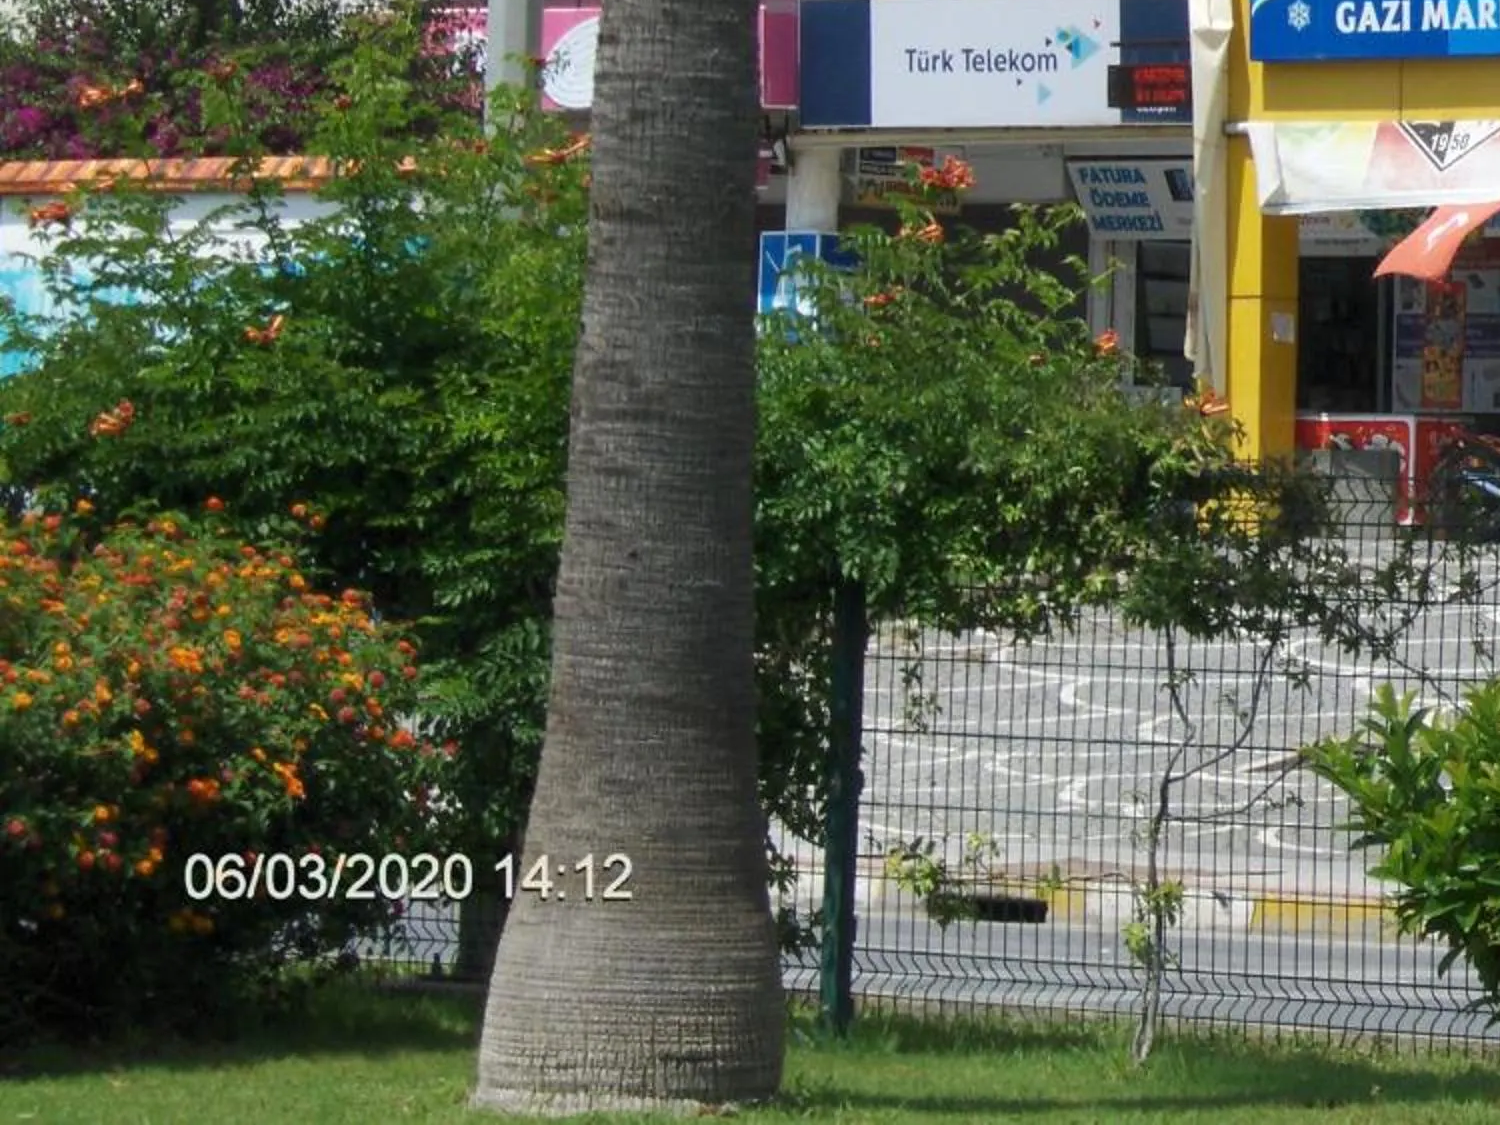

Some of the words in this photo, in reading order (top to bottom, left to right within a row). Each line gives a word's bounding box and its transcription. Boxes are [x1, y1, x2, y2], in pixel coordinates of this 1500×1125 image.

[905, 48, 954, 73] Türk
[962, 48, 1058, 73] Telekom
[1078, 165, 1147, 184] FATURA
